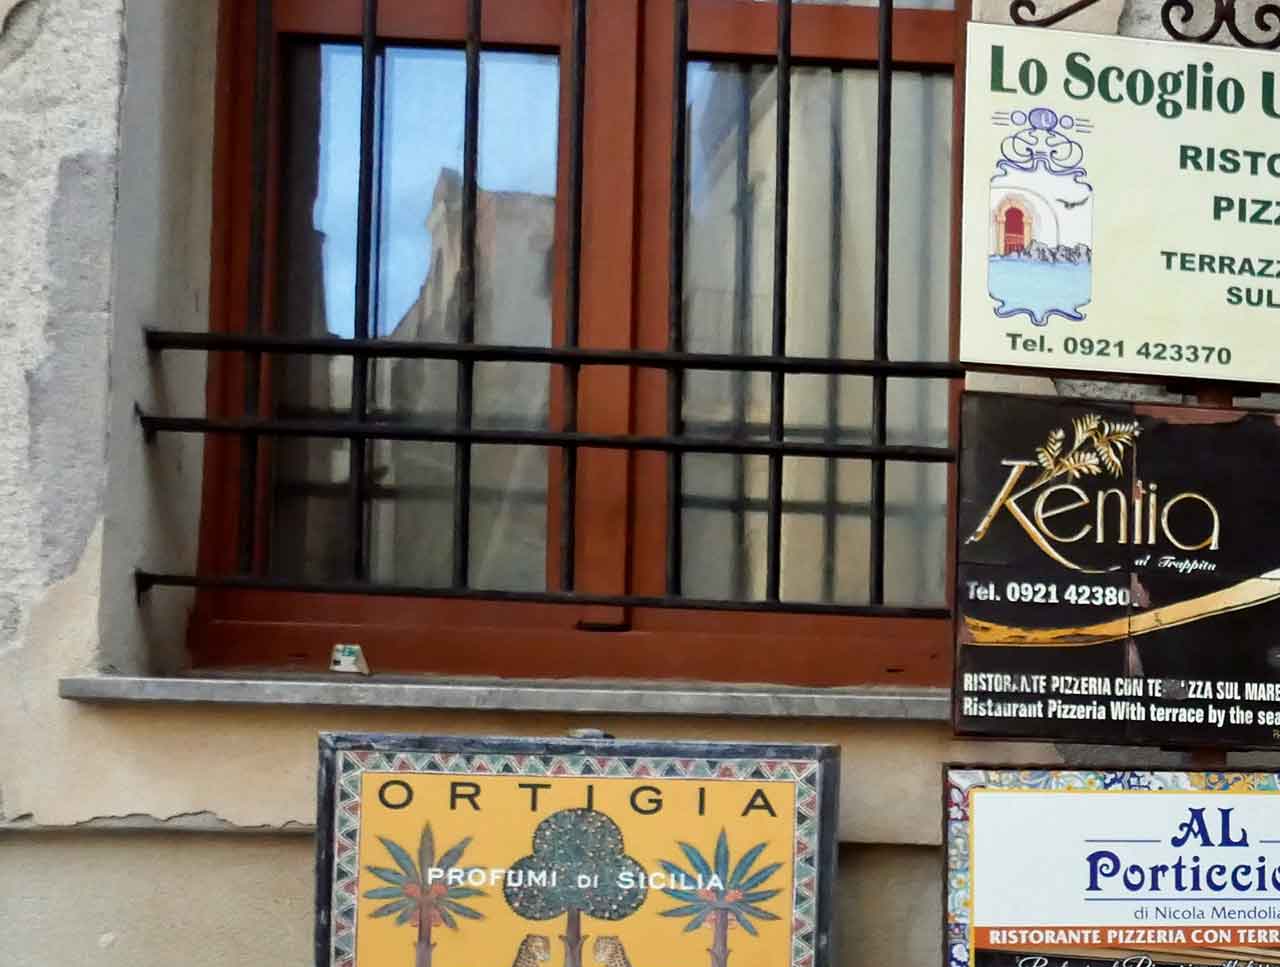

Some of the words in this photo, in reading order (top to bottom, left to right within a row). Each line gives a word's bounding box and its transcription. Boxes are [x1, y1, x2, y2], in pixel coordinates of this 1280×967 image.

[990, 45, 1047, 95] Lo
[1063, 51, 1244, 119] Scoglio
[1226, 287, 1280, 309] SUL
[1007, 333, 1053, 353] Tel.
[1063, 337, 1124, 358] 0921
[1137, 343, 1232, 365] 423370
[966, 581, 1001, 601] Tel.
[1006, 584, 1060, 604] 0921
[1064, 586, 1140, 609] 42380
[1051, 676, 1111, 696] PIZZERIA
[1114, 678, 1144, 696] CON
[1147, 679, 1213, 699] TEZZA
[1216, 680, 1241, 699] SUL
[1047, 700, 1106, 720] Pizzeria
[1110, 701, 1146, 721] With
[1150, 705, 1204, 725] terrace
[1208, 705, 1230, 729] by
[1231, 707, 1253, 725] the
[378, 779, 777, 817] ORTIGIA
[1171, 807, 1249, 848] AL
[427, 867, 557, 888] PROFUMI
[616, 870, 725, 891] SICILIA
[1134, 905, 1149, 921] di
[1154, 905, 1205, 920] Nicola
[989, 928, 1101, 944] RISTORANTE
[1106, 929, 1186, 944] PIZZERIA
[1191, 929, 1232, 944] CON
